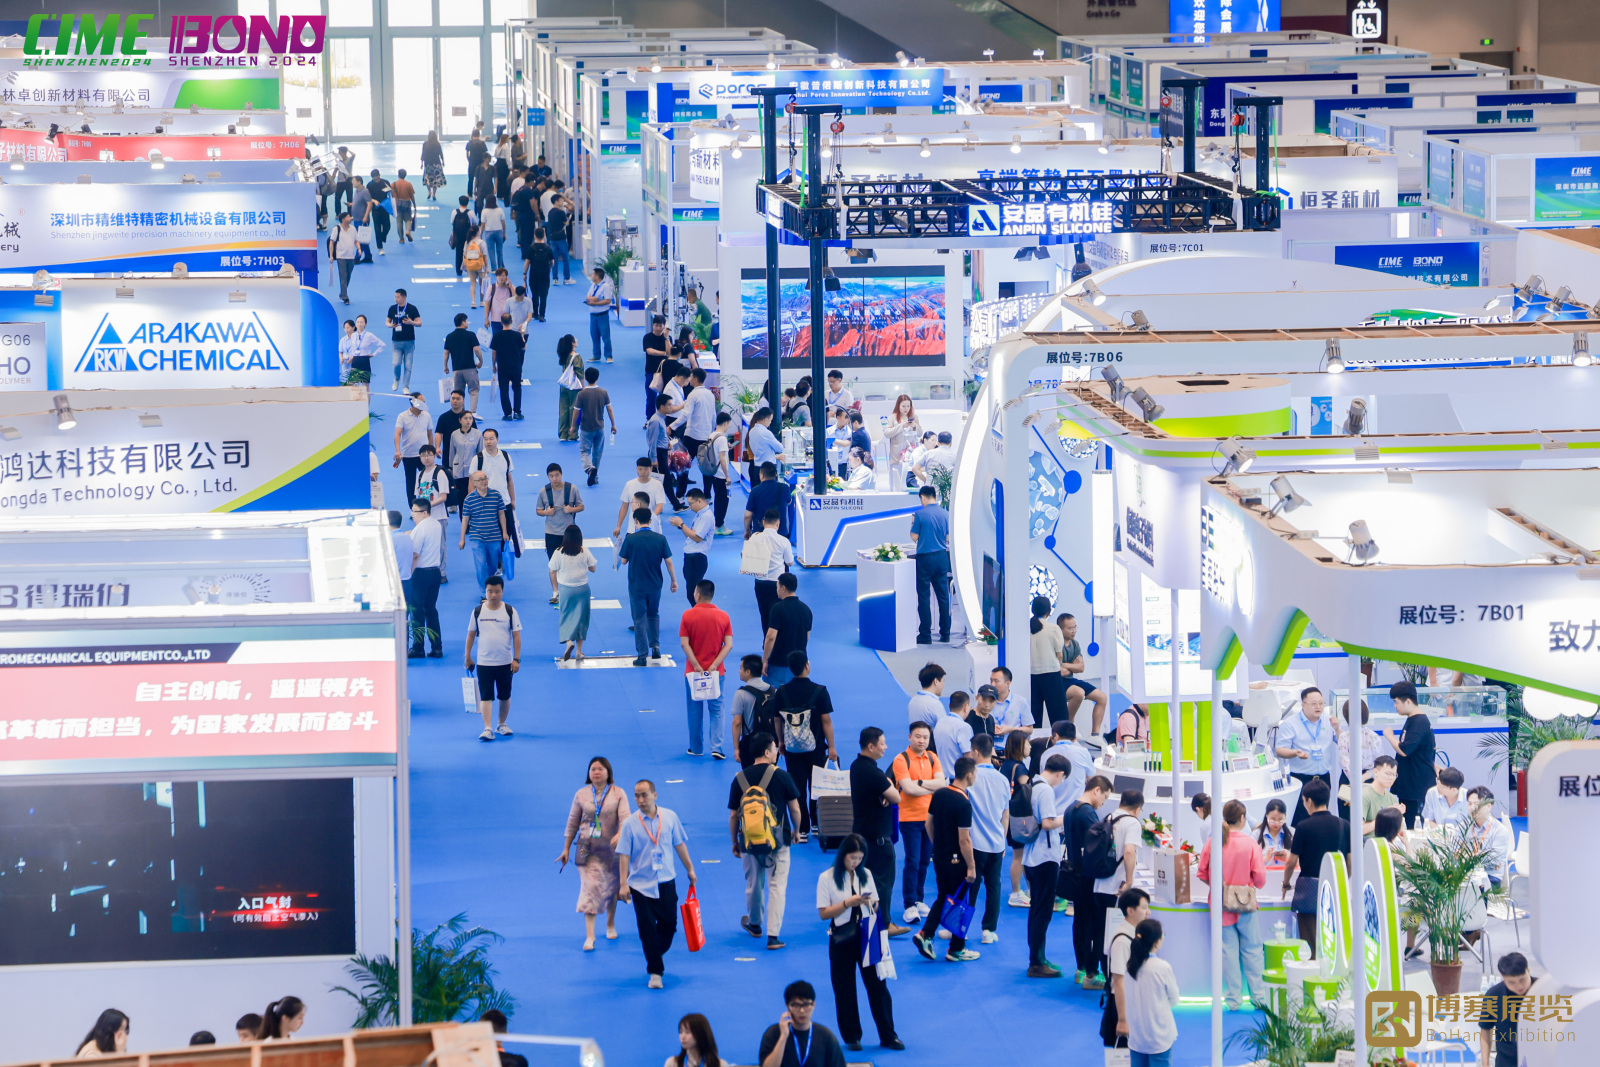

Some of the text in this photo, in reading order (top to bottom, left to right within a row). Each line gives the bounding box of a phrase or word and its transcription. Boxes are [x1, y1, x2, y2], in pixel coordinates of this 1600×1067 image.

[831, 90, 865, 98] Innovation
[868, 90, 905, 98] Technology
[609, 145, 628, 153] CIME
[1571, 166, 1592, 175] CIME
[51, 211, 286, 227] 深圳市精维特精密机械设备有限公司
[682, 210, 704, 218] CIME
[1002, 202, 1113, 224] 安品有机硅
[0, 222, 21, 239] 械
[51, 231, 91, 239] Shenzhen
[92, 231, 129, 241] jingweite
[131, 230, 168, 241] precision
[170, 229, 212, 239] machinery
[214, 229, 258, 239] equipment
[275, 228, 286, 237] ltd
[1002, 222, 1113, 236] ANPIN SILICONE
[1378, 256, 1444, 266] CIME BOND
[127, 322, 261, 344] ARAKAWA
[94, 348, 128, 371] RKW
[138, 348, 281, 371] CHEMICAL
[52, 483, 155, 503] Technology
[823, 498, 864, 506] 安品有机硅
